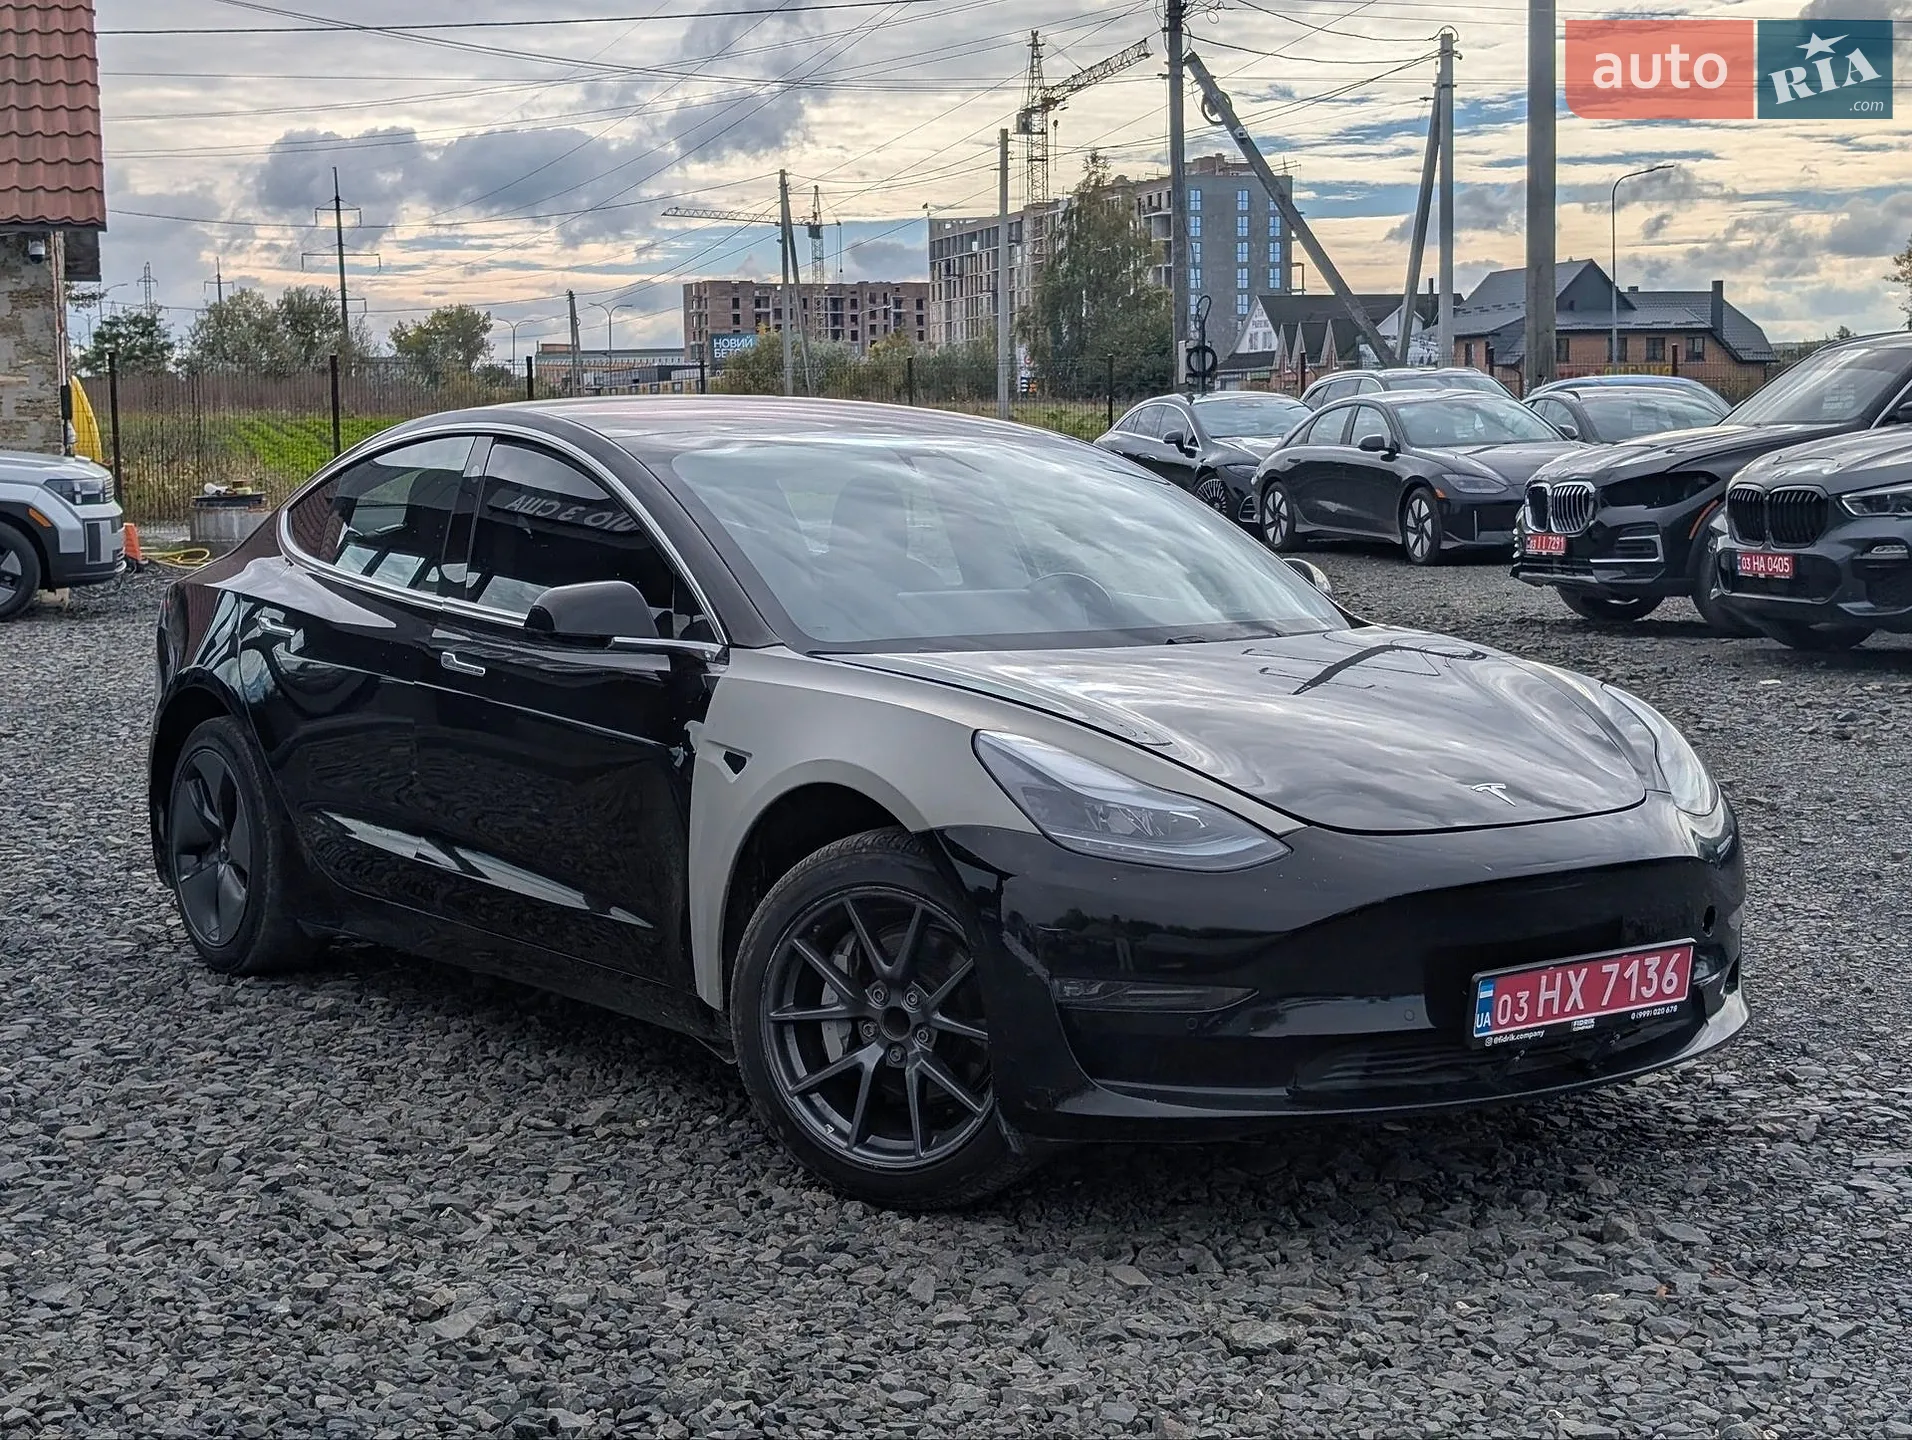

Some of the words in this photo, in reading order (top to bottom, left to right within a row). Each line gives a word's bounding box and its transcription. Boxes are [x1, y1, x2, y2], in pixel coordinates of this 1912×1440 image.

[713, 336, 753, 348] НОВИЙ
[1741, 556, 1751, 570] 03
[1752, 555, 1766, 571] HA
[1767, 556, 1790, 573] 0405
[1496, 990, 1530, 1025] 03
[1536, 967, 1588, 1018] HX
[1600, 952, 1681, 1006] 7136
[1476, 1011, 1491, 1028] UA
